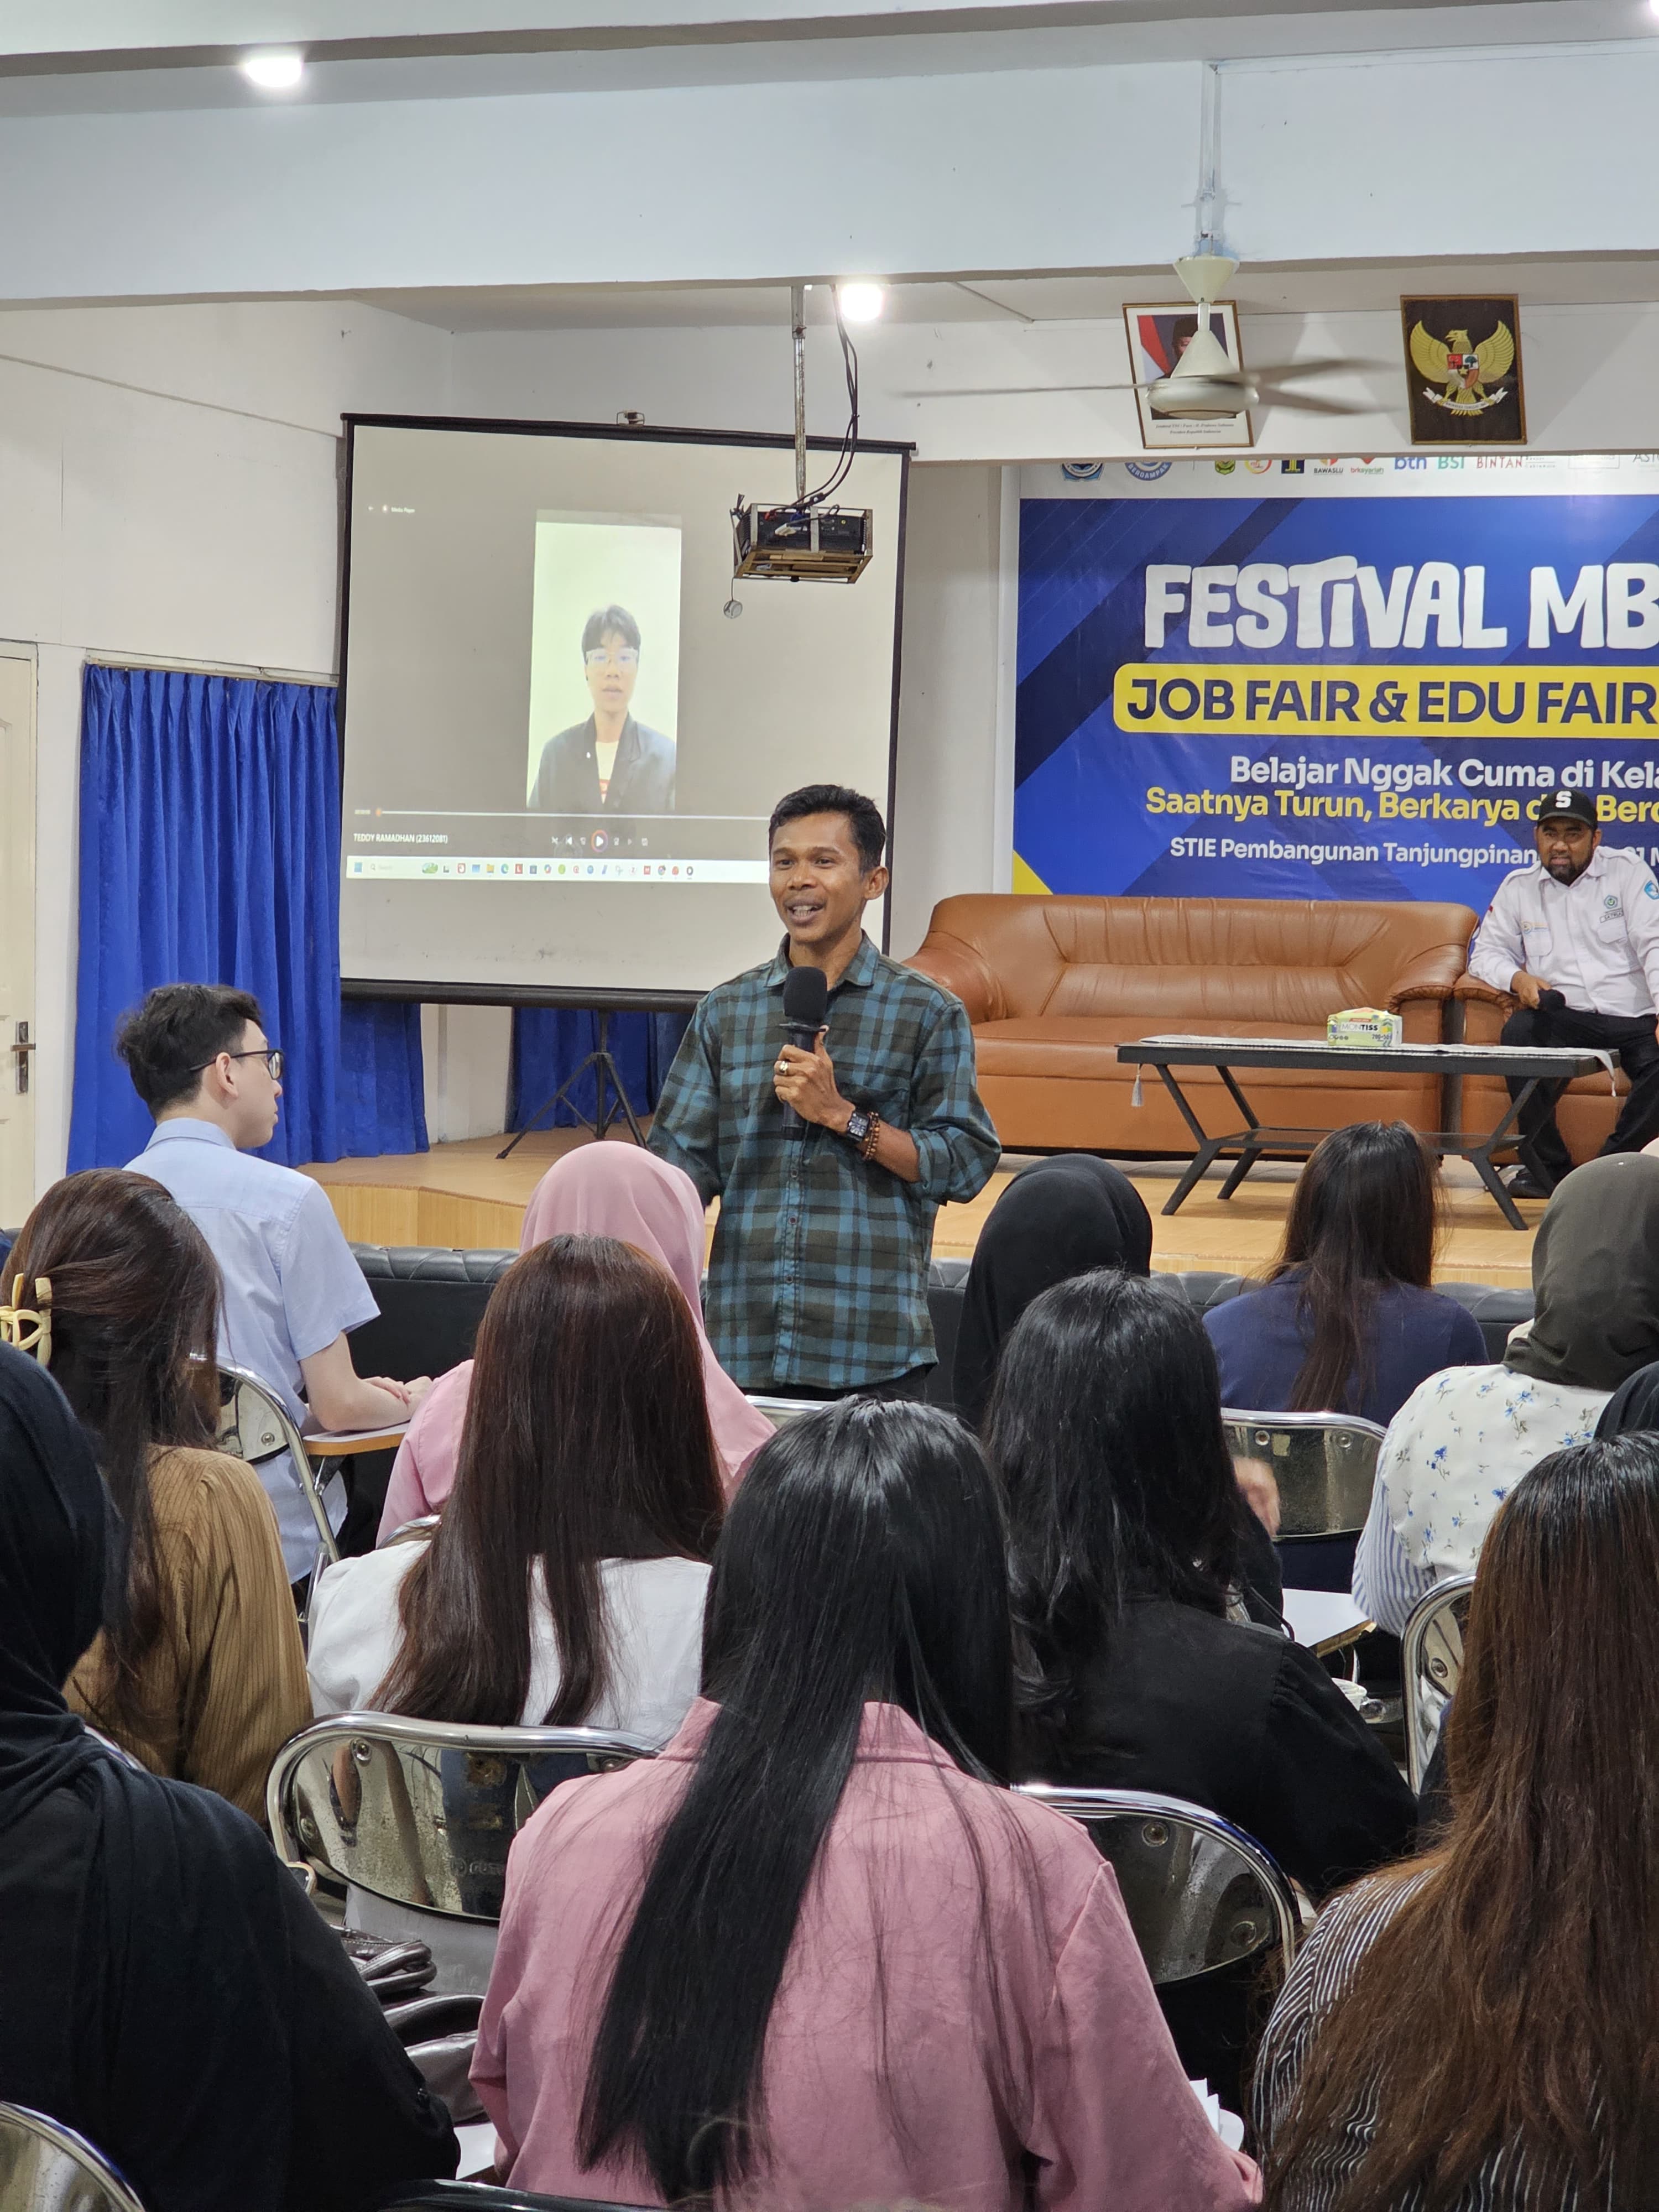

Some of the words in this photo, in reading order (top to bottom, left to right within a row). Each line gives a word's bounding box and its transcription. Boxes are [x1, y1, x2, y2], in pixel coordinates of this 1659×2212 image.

[1394, 457, 1427, 469] btn
[1438, 457, 1464, 469] BSI
[1476, 456, 1522, 468] BINTAN
[1145, 555, 1507, 649] FESTIVAL
[1128, 679, 1235, 720] JOB
[1246, 680, 1361, 722] FAIR
[1369, 681, 1408, 722] &
[1418, 681, 1525, 724] EDU
[1537, 682, 1658, 724] FAIR
[1231, 755, 1339, 790] Belajar
[1344, 757, 1453, 791] Nggak
[1458, 759, 1554, 788] Cuma
[1561, 760, 1594, 788] di
[1146, 786, 1269, 822] Saatnya
[1274, 789, 1373, 823] Turun,
[1379, 791, 1520, 827] Berkarya
[1555, 790, 1572, 808] S
[353, 833, 375, 842] TEDDY
[375, 833, 415, 843] RAMADHAN
[1170, 837, 1217, 858] STIE
[1221, 838, 1379, 865] Pembangunan
[1383, 842, 1541, 868] Tanjungpinan
